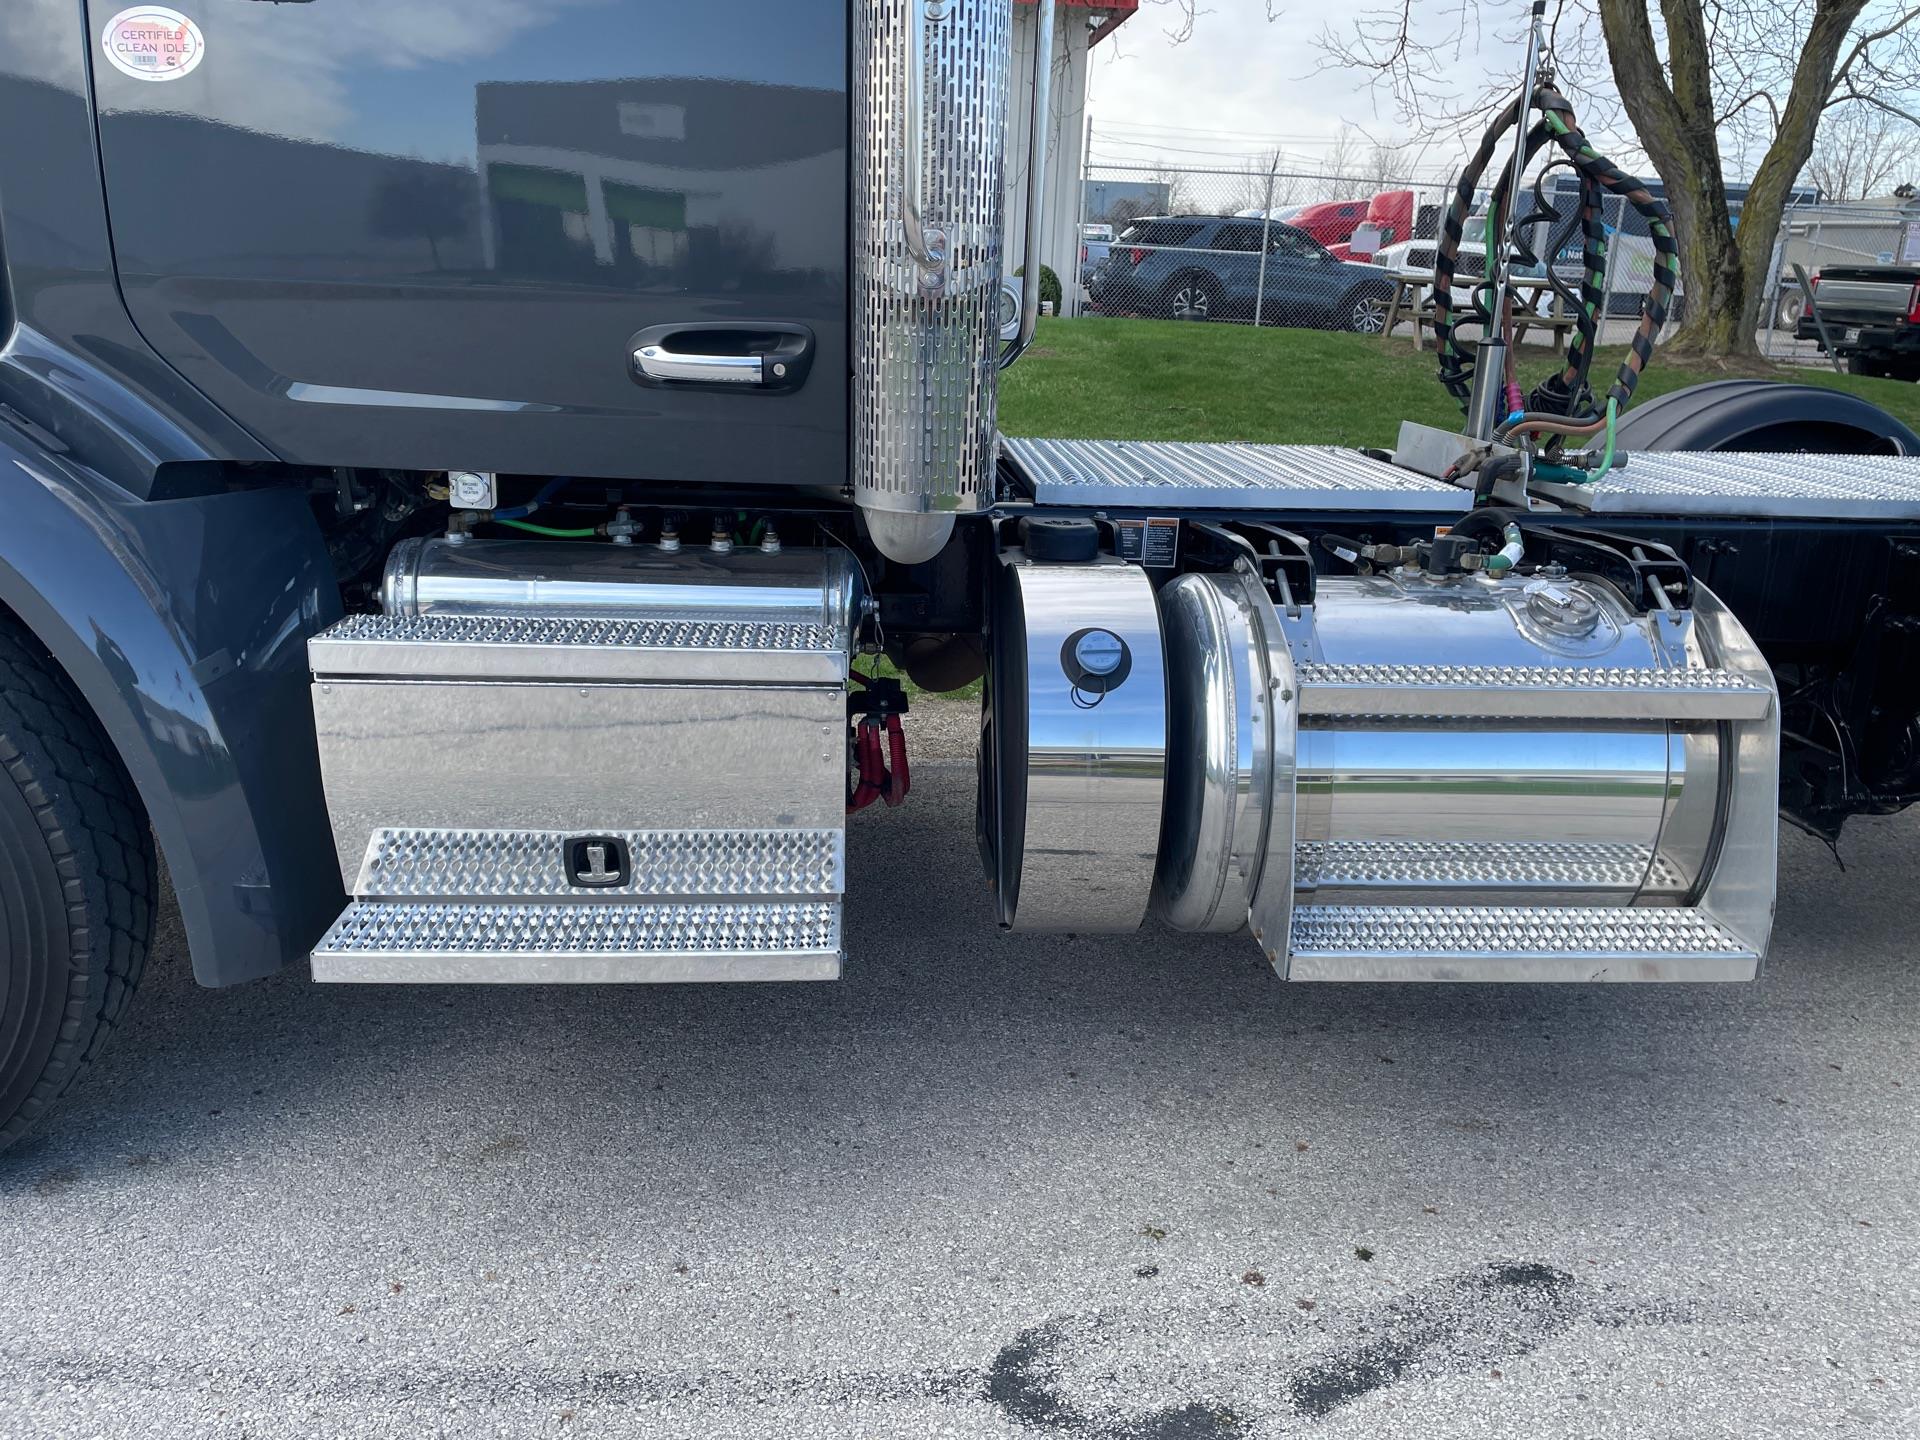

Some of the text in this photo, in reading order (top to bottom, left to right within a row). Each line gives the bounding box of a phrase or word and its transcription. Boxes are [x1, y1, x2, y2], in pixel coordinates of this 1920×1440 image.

[121, 30, 183, 40] CERTIFIED
[117, 43, 191, 53] CLEAN IDLE
